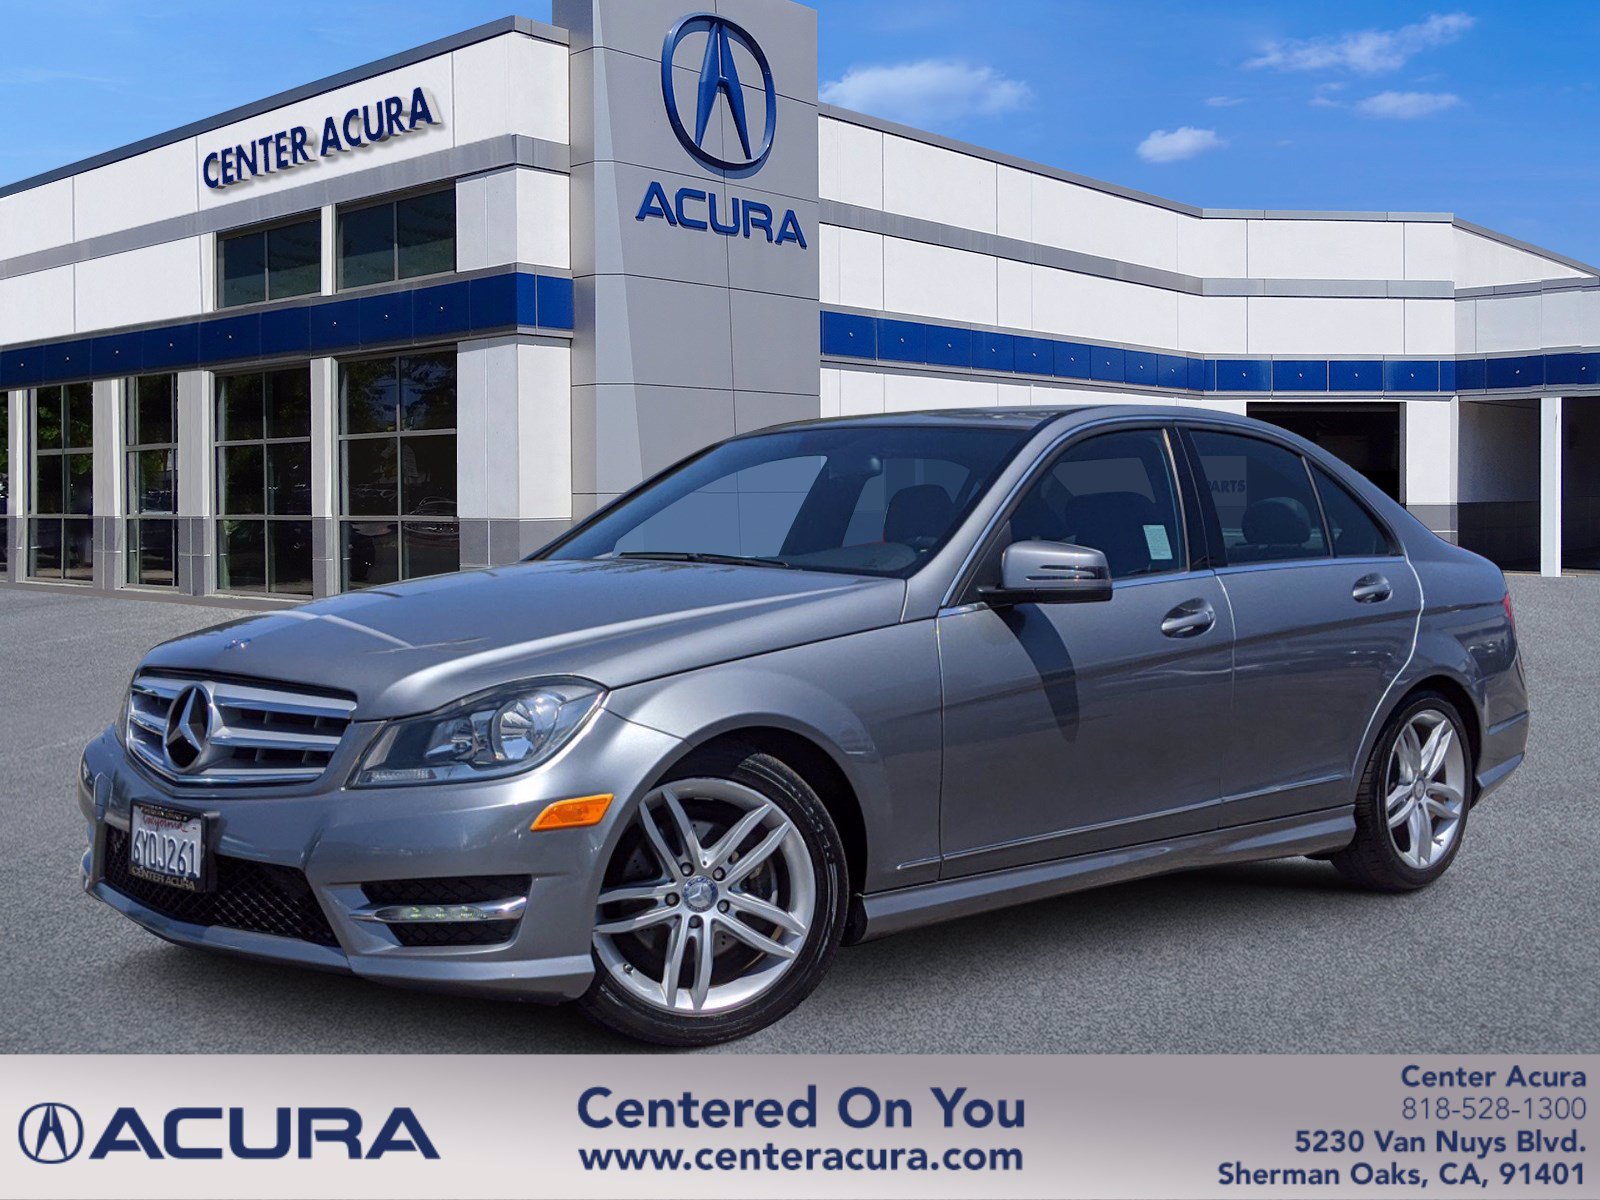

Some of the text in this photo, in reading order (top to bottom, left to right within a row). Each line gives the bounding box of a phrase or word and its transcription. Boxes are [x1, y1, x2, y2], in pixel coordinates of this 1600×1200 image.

[203, 86, 433, 188] CENTER ACURA
[635, 181, 807, 249] ACURA
[166, 876, 195, 890] ACURA
